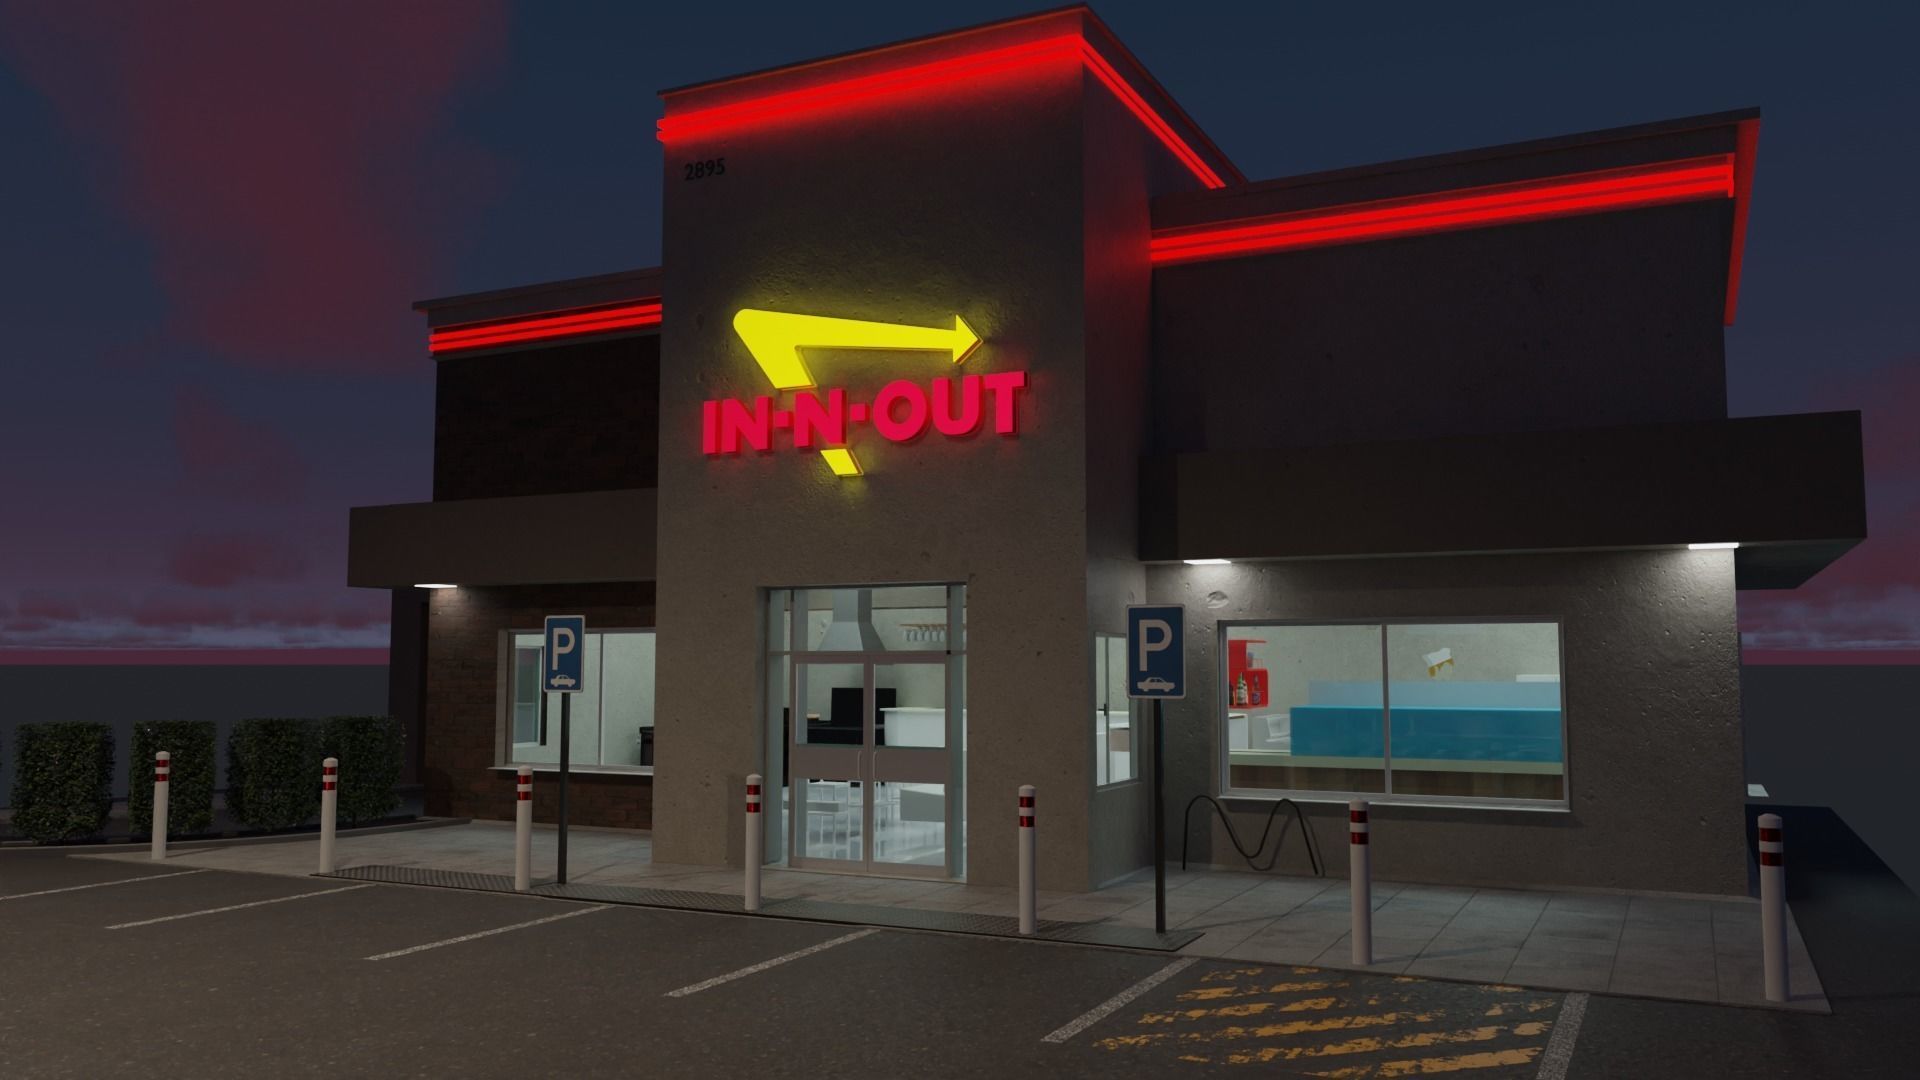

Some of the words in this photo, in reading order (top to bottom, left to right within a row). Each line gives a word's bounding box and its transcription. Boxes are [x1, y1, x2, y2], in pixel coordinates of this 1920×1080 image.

[685, 158, 725, 180] 2895
[553, 628, 575, 670] P
[1140, 620, 1172, 671] P
